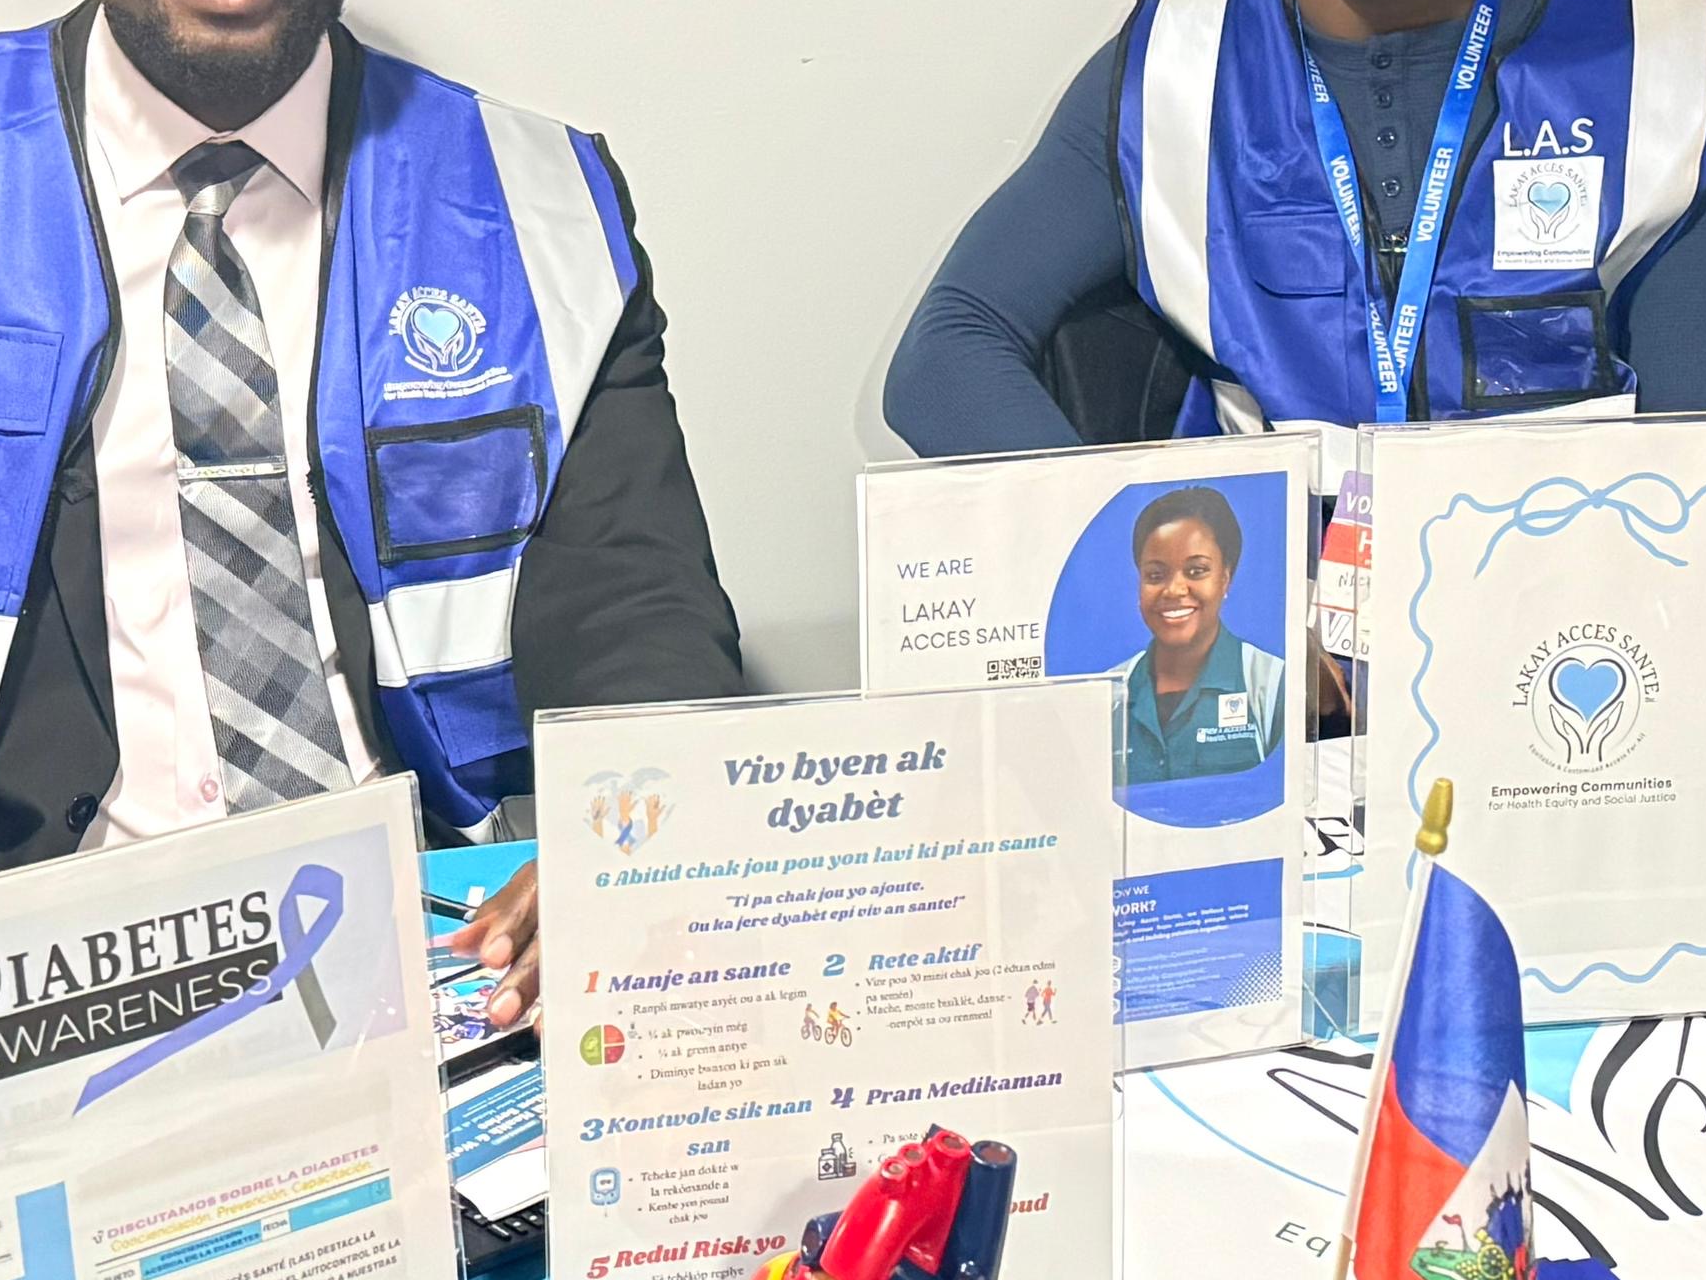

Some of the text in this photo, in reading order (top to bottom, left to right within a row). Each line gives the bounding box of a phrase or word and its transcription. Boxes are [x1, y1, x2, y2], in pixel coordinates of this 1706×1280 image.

[1455, 4, 1493, 90] VOLUNTEER
[1503, 117, 1594, 157] L.A.S
[1415, 147, 1453, 243] VOLUNTEER
[1370, 302, 1398, 394] VOLUNTEER
[897, 557, 975, 580] WE ARE
[902, 597, 977, 624] LAKAY
[900, 622, 1041, 652] ACCES SANTE
[1513, 623, 1661, 707] LAKAY ACCES SANTE
[724, 740, 946, 787] Viv byen ak
[1488, 800, 1504, 811] for
[1507, 798, 1542, 810] Health
[1545, 796, 1579, 810] Equity
[1604, 794, 1637, 806] Social
[1491, 777, 1673, 800] Empowering Communities
[767, 788, 904, 835] dyabèt
[595, 832, 1057, 888] 6 Abitid chak jou pou yon lavi ki pi an sante
[752, 894, 772, 908] pa
[775, 888, 816, 903] chak
[818, 886, 844, 902] jou
[846, 886, 866, 899] yo
[869, 878, 924, 897] ajoute.
[583, 959, 791, 996] 1 Manje an sante
[822, 943, 982, 977] 2 Rete aktif
[830, 1068, 1062, 1109] 4 Pran Medikaman
[579, 1098, 812, 1142] 3 Kontwole sik nan
[686, 1138, 730, 1157] san
[107, 1143, 379, 1239] DISCUTAMOS SOBRE LA DIABETES
[586, 1234, 786, 1280] 5 Redui Risk yo
